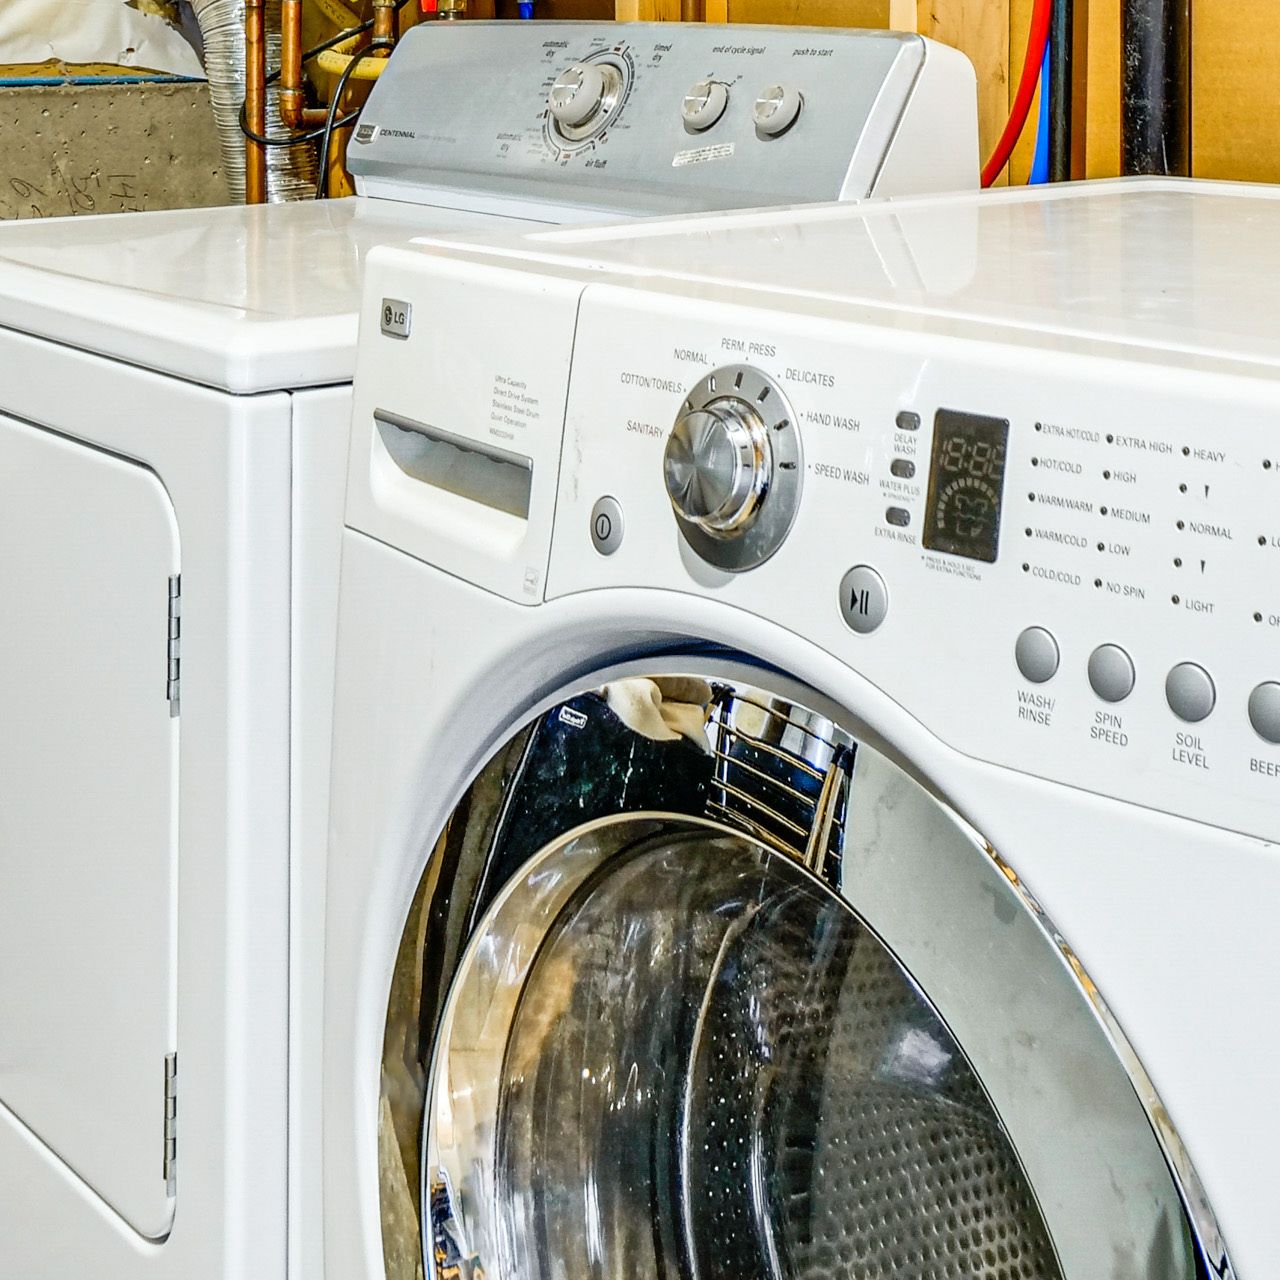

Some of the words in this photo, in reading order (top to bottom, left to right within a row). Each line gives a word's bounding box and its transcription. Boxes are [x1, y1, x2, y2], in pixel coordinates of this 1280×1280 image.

[654, 44, 673, 52] timed
[712, 45, 724, 53] end
[724, 45, 732, 54] of
[731, 46, 745, 55] cycle
[746, 46, 766, 56] signal
[792, 48, 809, 58] push
[817, 49, 834, 57] start
[379, 128, 416, 139] CENTENNIAL
[393, 311, 406, 325] LG
[673, 348, 709, 365] NORMAL
[721, 338, 746, 353] PERM.
[749, 342, 776, 357] PRESS
[620, 372, 682, 394] COTTON/TOWELS
[785, 368, 835, 387] DELICATES
[626, 419, 664, 439] SANITARY
[806, 411, 830, 427] HAND
[833, 416, 860, 432] WASH
[894, 432, 917, 445] DELAY
[1043, 423, 1065, 437] EXTRA
[1066, 427, 1100, 443] HOT/COLD
[894, 445, 916, 456] WASH
[1116, 436, 1147, 450] EXTRA
[1149, 440, 1173, 454] HIGH
[1193, 448, 1226, 463] HEAVY
[814, 463, 842, 481] SPEED
[843, 469, 870, 486] WASH
[1040, 458, 1082, 474] HOT/COLD
[1113, 470, 1137, 483] HIGH
[879, 478, 902, 492] WATER
[903, 482, 920, 496] PLUS
[1037, 493, 1093, 513] WARM/WARM
[1110, 508, 1151, 524] MEDIUM
[875, 526, 897, 541] EXTRA
[897, 531, 918, 545] RINSE
[1035, 528, 1088, 548] WARM/COLD
[1189, 521, 1233, 540] NORMAL
[1108, 543, 1131, 557] LOW
[1032, 566, 1081, 586] COLD/COLD
[1106, 581, 1121, 595] NO
[1123, 585, 1146, 600] SPIN
[1185, 598, 1215, 614] LIGHT
[1017, 690, 1056, 712] WASH/
[1018, 706, 1052, 727] RINSE
[1094, 711, 1122, 729] SPIN
[1090, 726, 1129, 747] SPEED
[1175, 732, 1204, 752] SOIL
[1172, 748, 1210, 770] LEVEL
